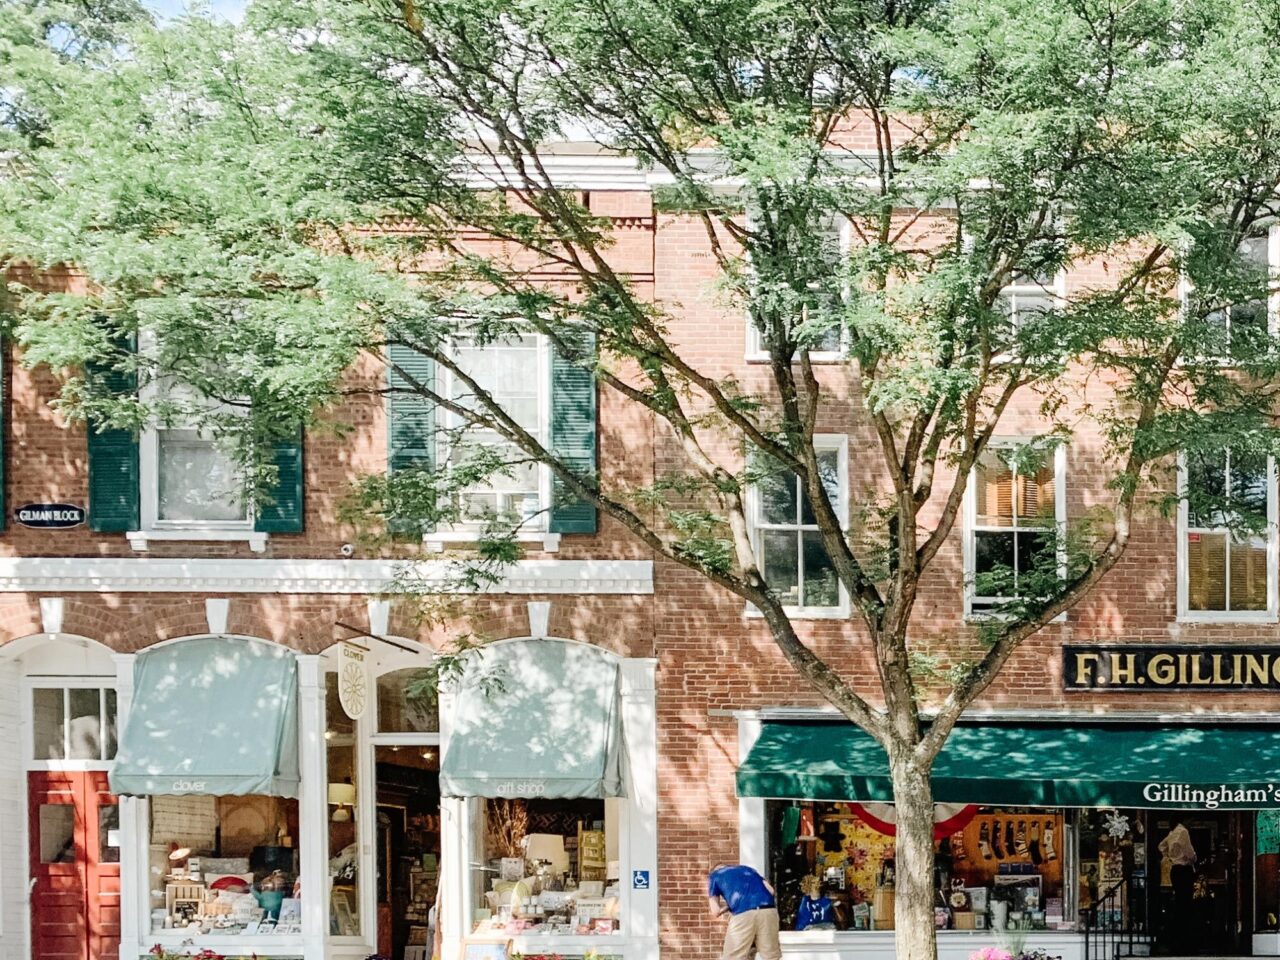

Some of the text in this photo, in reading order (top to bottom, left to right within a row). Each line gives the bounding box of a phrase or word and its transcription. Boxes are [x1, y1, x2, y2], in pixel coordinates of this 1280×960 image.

[19, 510, 80, 521] GILMAN BLOCK
[172, 779, 208, 791] clover
[496, 781, 545, 796] gift shop
